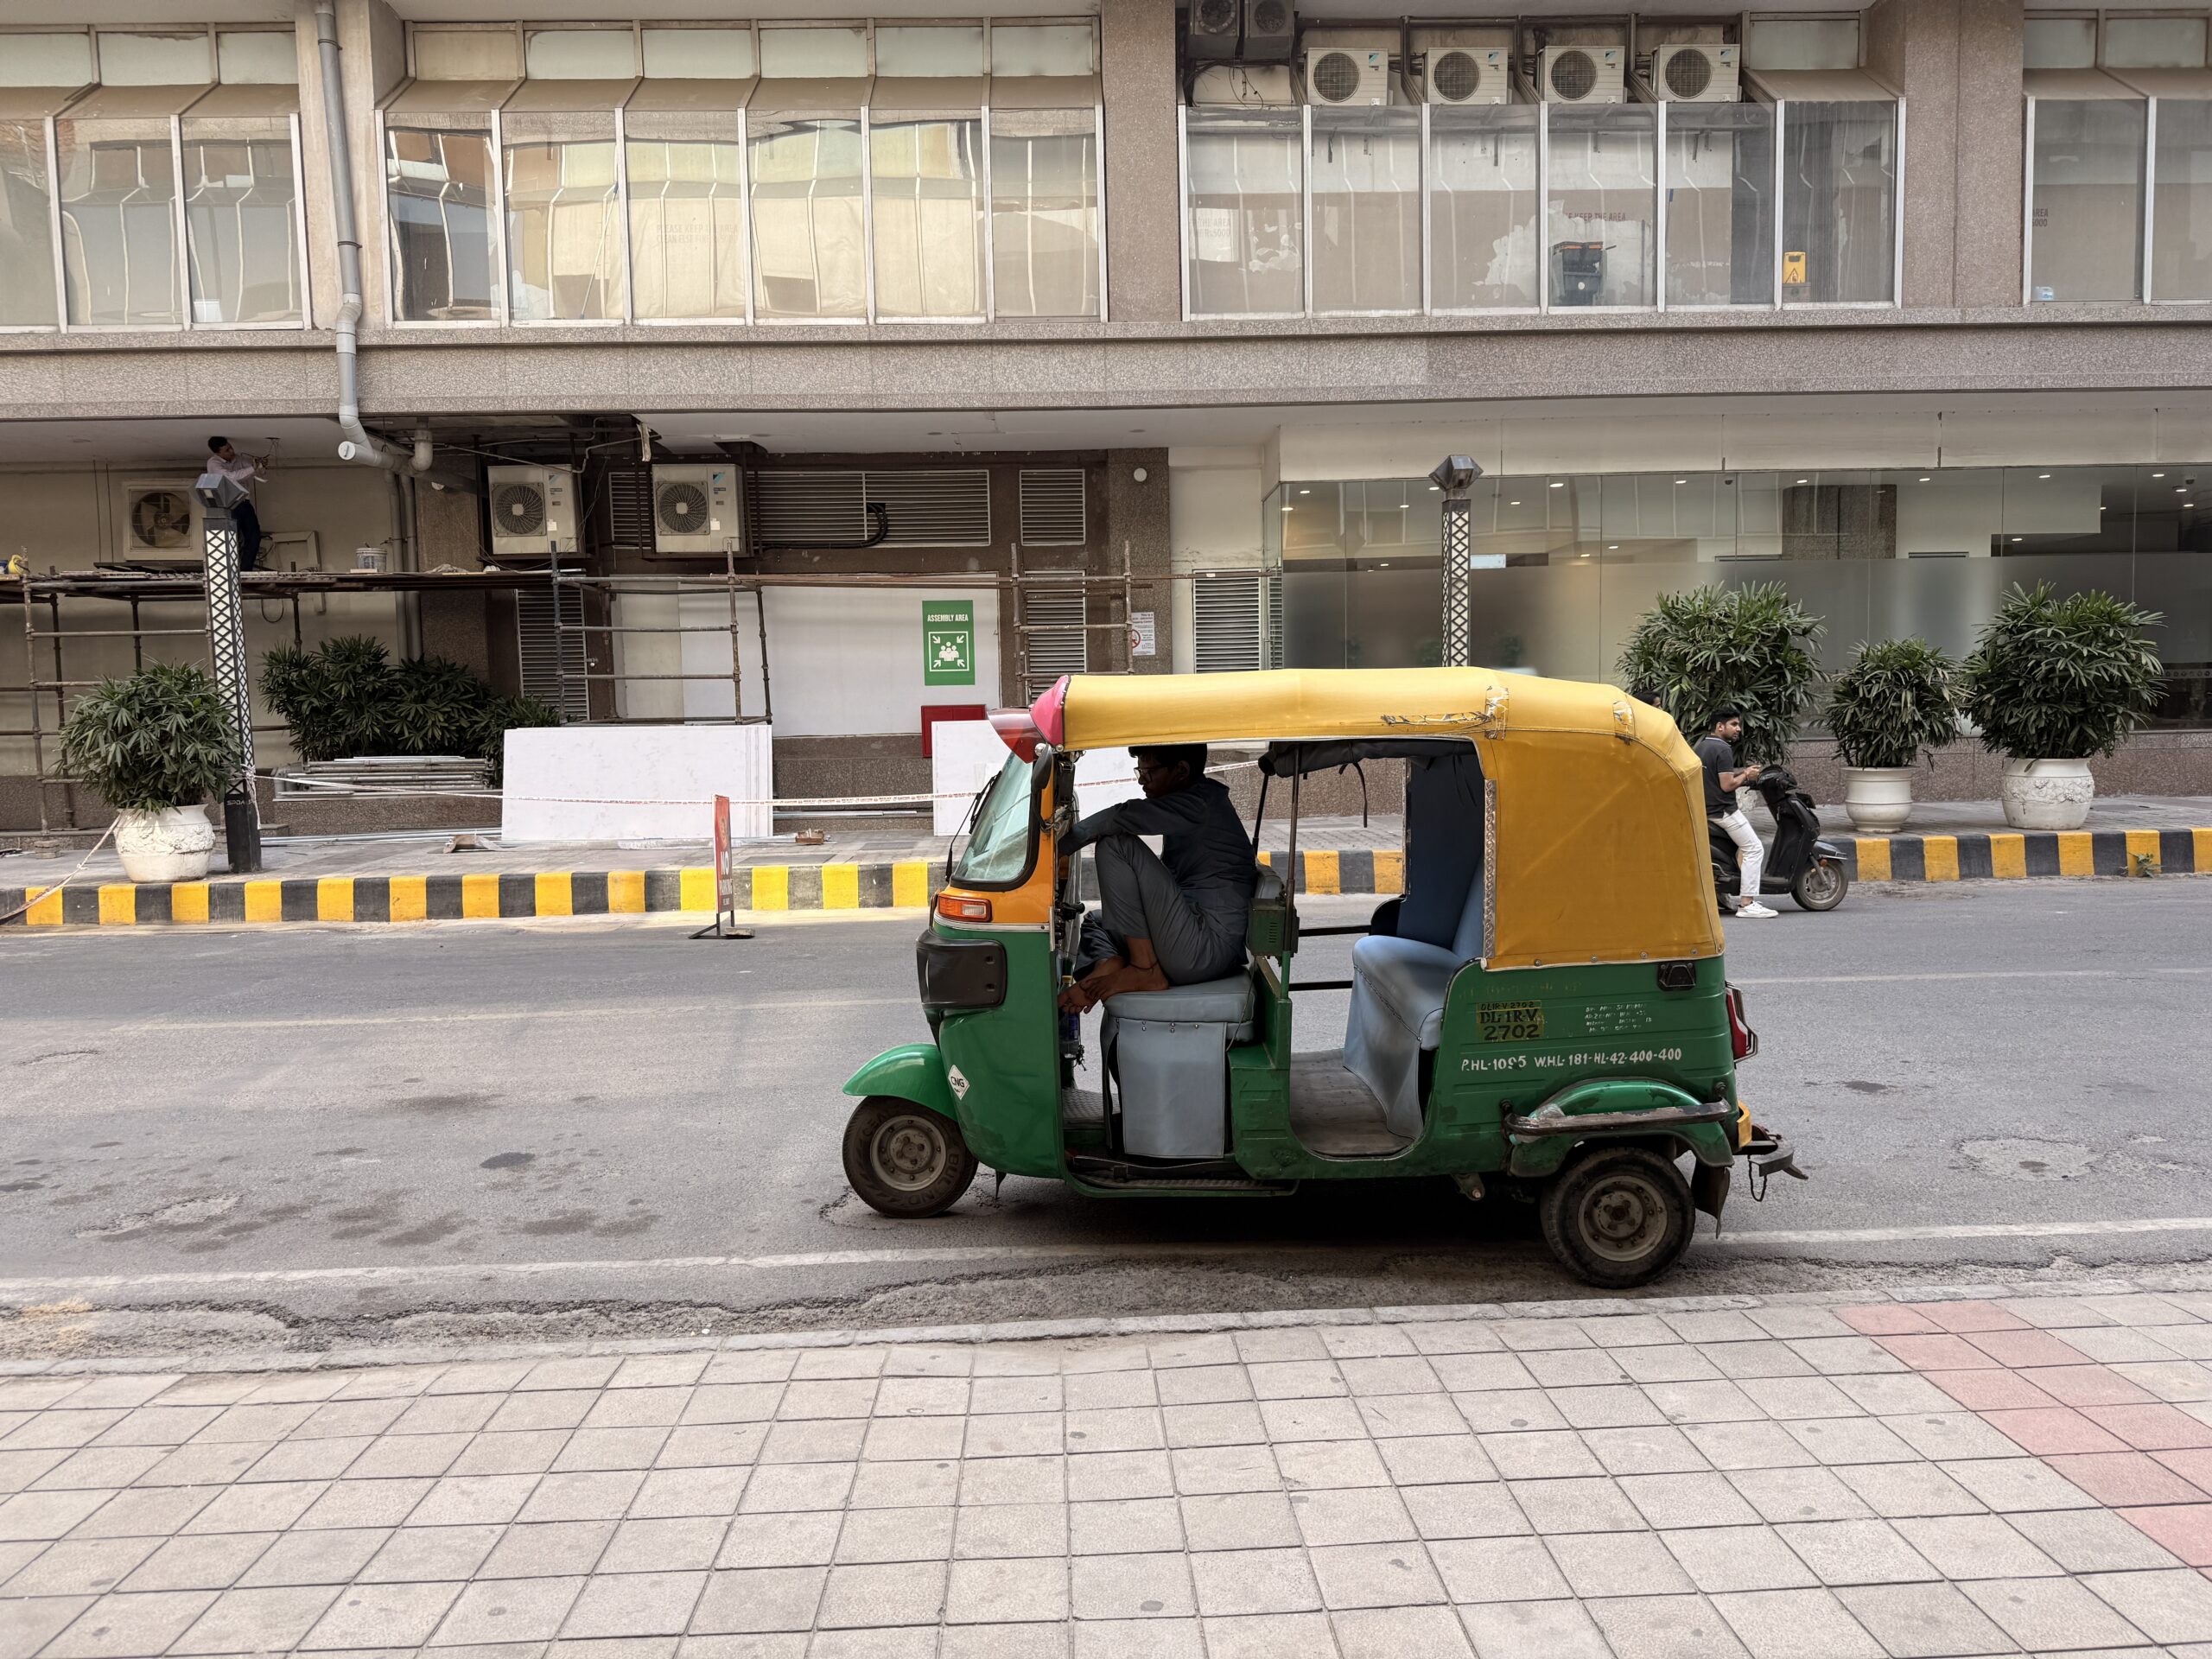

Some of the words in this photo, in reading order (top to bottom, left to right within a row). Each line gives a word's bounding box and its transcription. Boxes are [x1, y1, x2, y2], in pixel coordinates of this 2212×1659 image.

[1608, 213, 1626, 221] AREA
[657, 224, 683, 233] PEASE
[720, 851, 729, 875] NO
[1510, 1001, 1535, 1009] 2702
[1483, 1023, 1540, 1041] 2702
[950, 1076, 965, 1088] CNG
